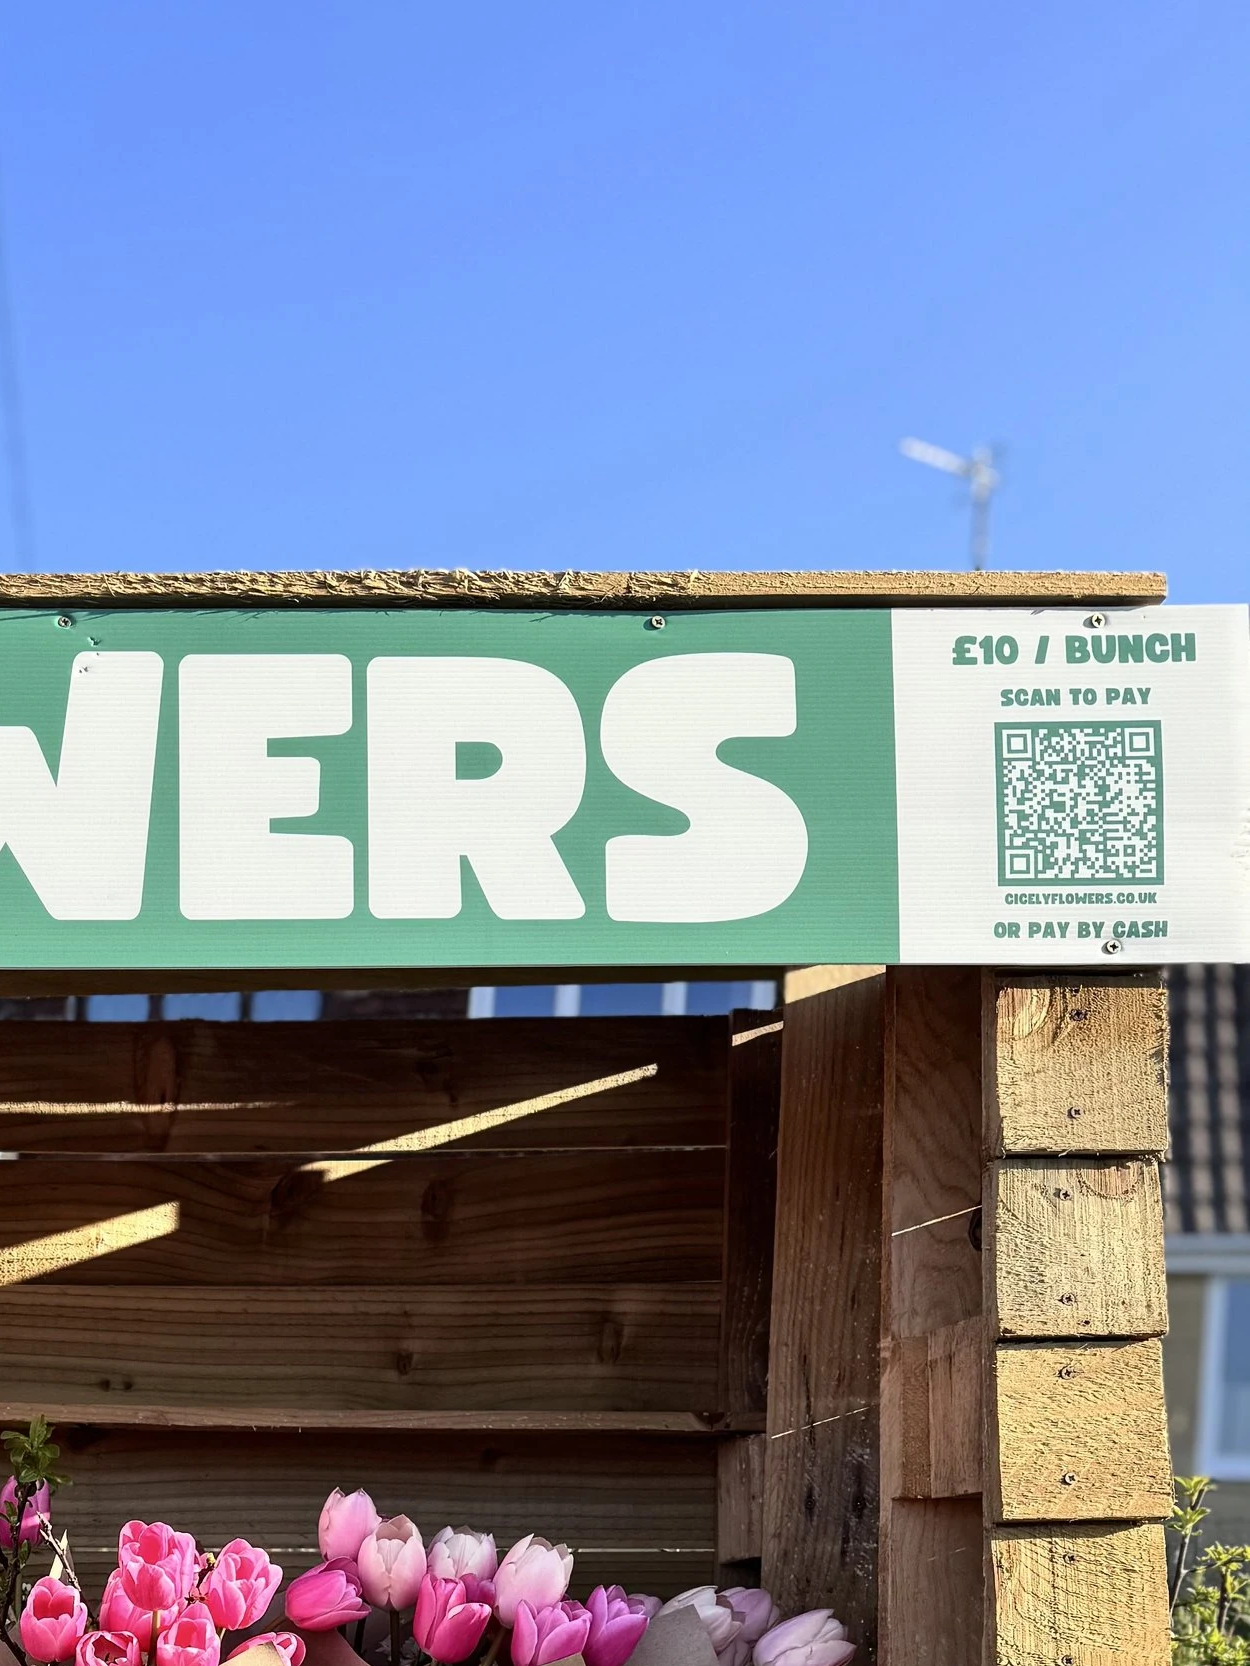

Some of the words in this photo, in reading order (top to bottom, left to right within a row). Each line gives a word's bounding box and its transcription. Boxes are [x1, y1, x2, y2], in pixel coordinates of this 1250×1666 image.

[952, 635, 1019, 665] £10
[1034, 635, 1050, 665] /
[1065, 632, 1196, 665] BUNCH
[1000, 688, 1061, 707] SCAN
[1068, 687, 1098, 706] TO
[1105, 687, 1151, 706] PAY
[1004, 891, 1157, 905] CICELYFLOWERS.CO.UK
[993, 921, 1021, 939] OR
[1028, 921, 1070, 939] PAY
[1077, 921, 1104, 939] BY
[1112, 920, 1168, 939] CASH
